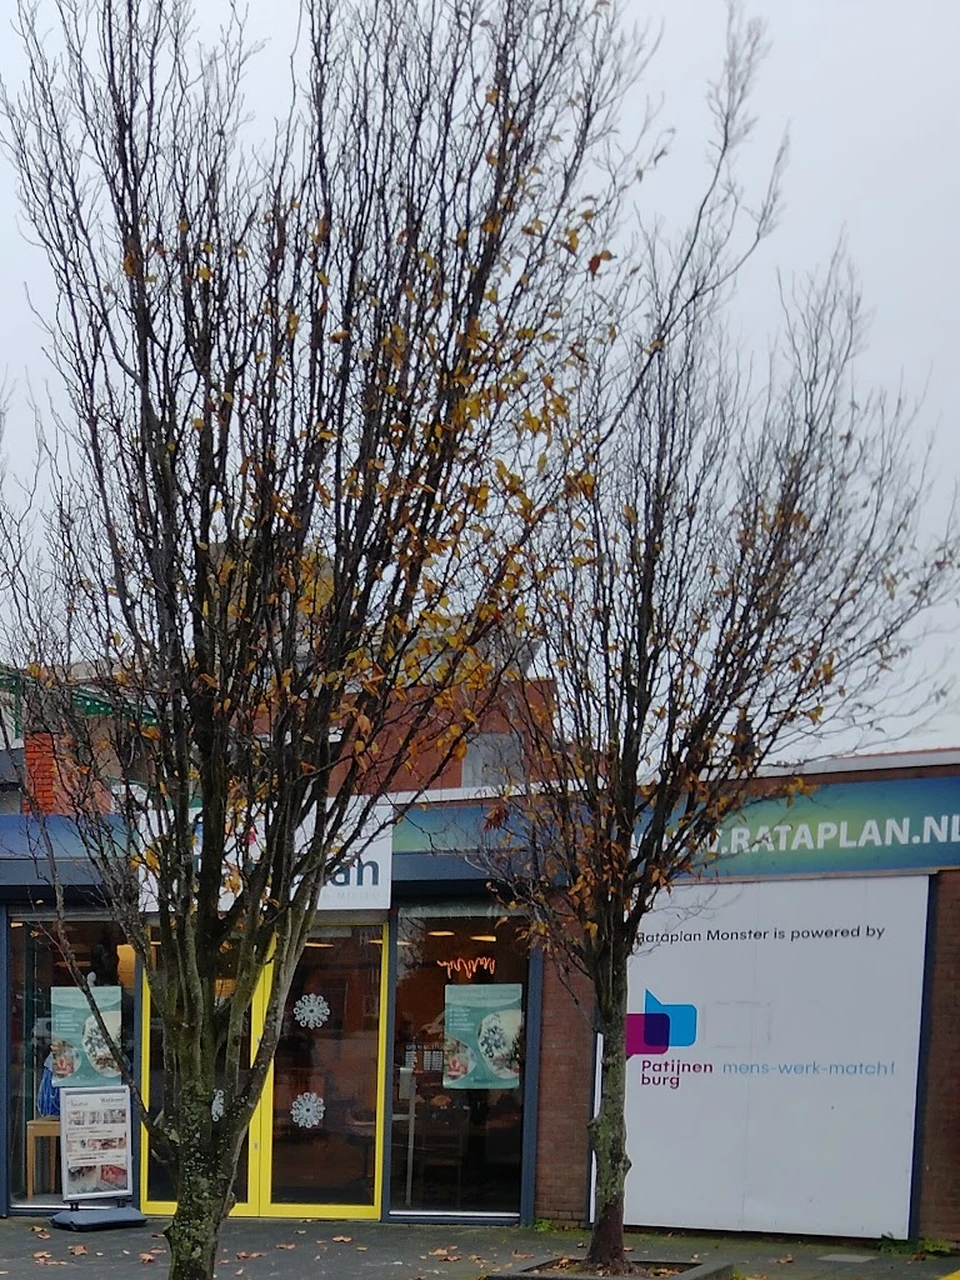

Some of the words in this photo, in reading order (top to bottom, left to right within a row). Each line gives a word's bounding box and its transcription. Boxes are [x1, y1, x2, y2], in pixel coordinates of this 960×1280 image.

[629, 814, 960, 858] .RATAPLAN.NL
[706, 928, 769, 942] Monster
[773, 927, 785, 940] is
[790, 925, 860, 942] powered
[866, 925, 886, 940] by
[641, 1059, 714, 1074] Patijnen
[722, 1060, 895, 1076] mens-werk-match!
[641, 1071, 680, 1090] burg
